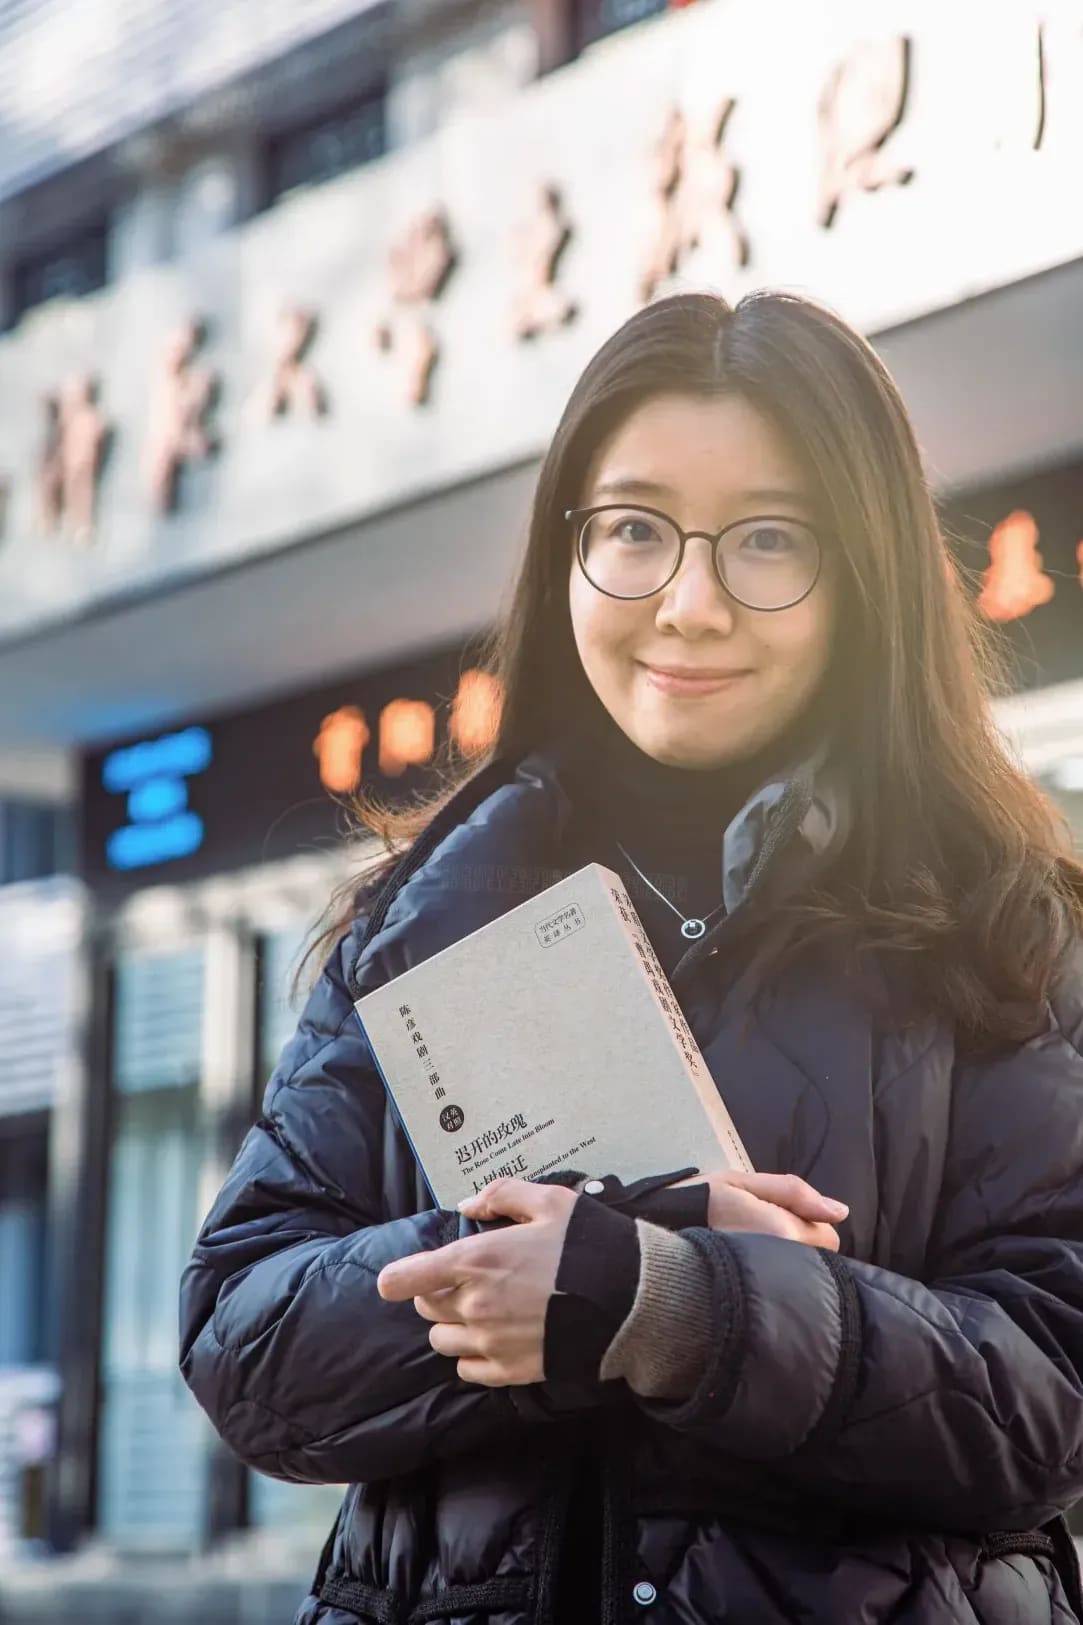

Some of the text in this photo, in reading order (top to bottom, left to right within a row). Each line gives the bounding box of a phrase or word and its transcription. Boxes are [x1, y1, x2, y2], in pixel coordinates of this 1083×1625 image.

[399, 1004, 446, 1100] 陈彦戏剧三部曲
[455, 1113, 528, 1165] 迟开的玫瑰
[462, 1118, 555, 1176] The Rose Come Late into Bloom
[562, 1151, 569, 1160] to
[569, 1146, 580, 1157] the
[580, 1136, 597, 1150] West
